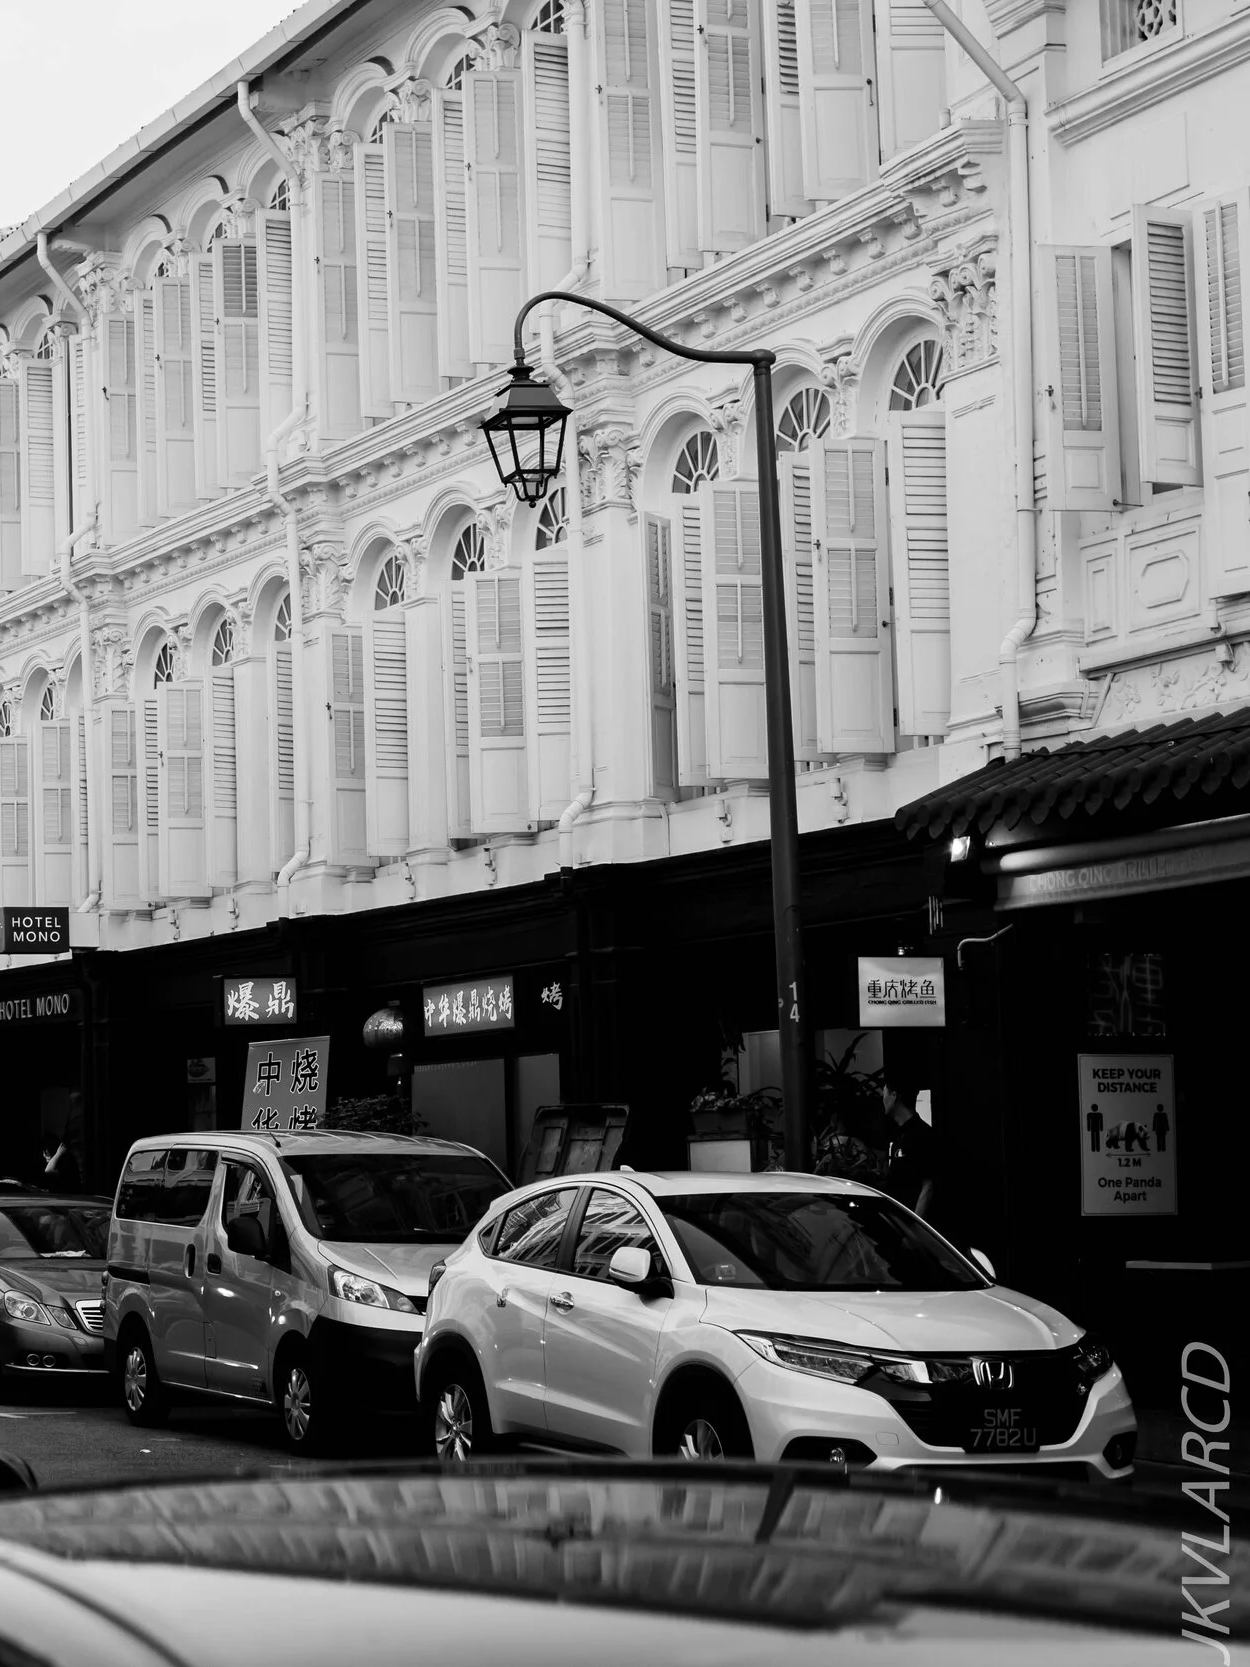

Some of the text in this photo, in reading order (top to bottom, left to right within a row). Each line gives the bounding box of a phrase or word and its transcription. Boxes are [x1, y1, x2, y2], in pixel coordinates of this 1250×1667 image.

[11, 917, 62, 928] HOTEL
[13, 931, 61, 942] MONO
[541, 981, 563, 1010] 烤
[867, 979, 937, 998] 重庆烤鱼
[36, 993, 70, 1016] MONO
[227, 981, 295, 1021] 爆鼎
[424, 984, 512, 1028] 中华爆鼎烧烤
[1092, 1068, 1161, 1079] KEEP YOUR
[1097, 1082, 1158, 1093] DISTANCE
[1117, 1158, 1141, 1167] 1.2 M
[1097, 1177, 1162, 1188] One Panda
[1113, 1191, 1147, 1204] Apart
[984, 1408, 1022, 1427] SMF
[970, 1428, 1037, 1447] 7782U
